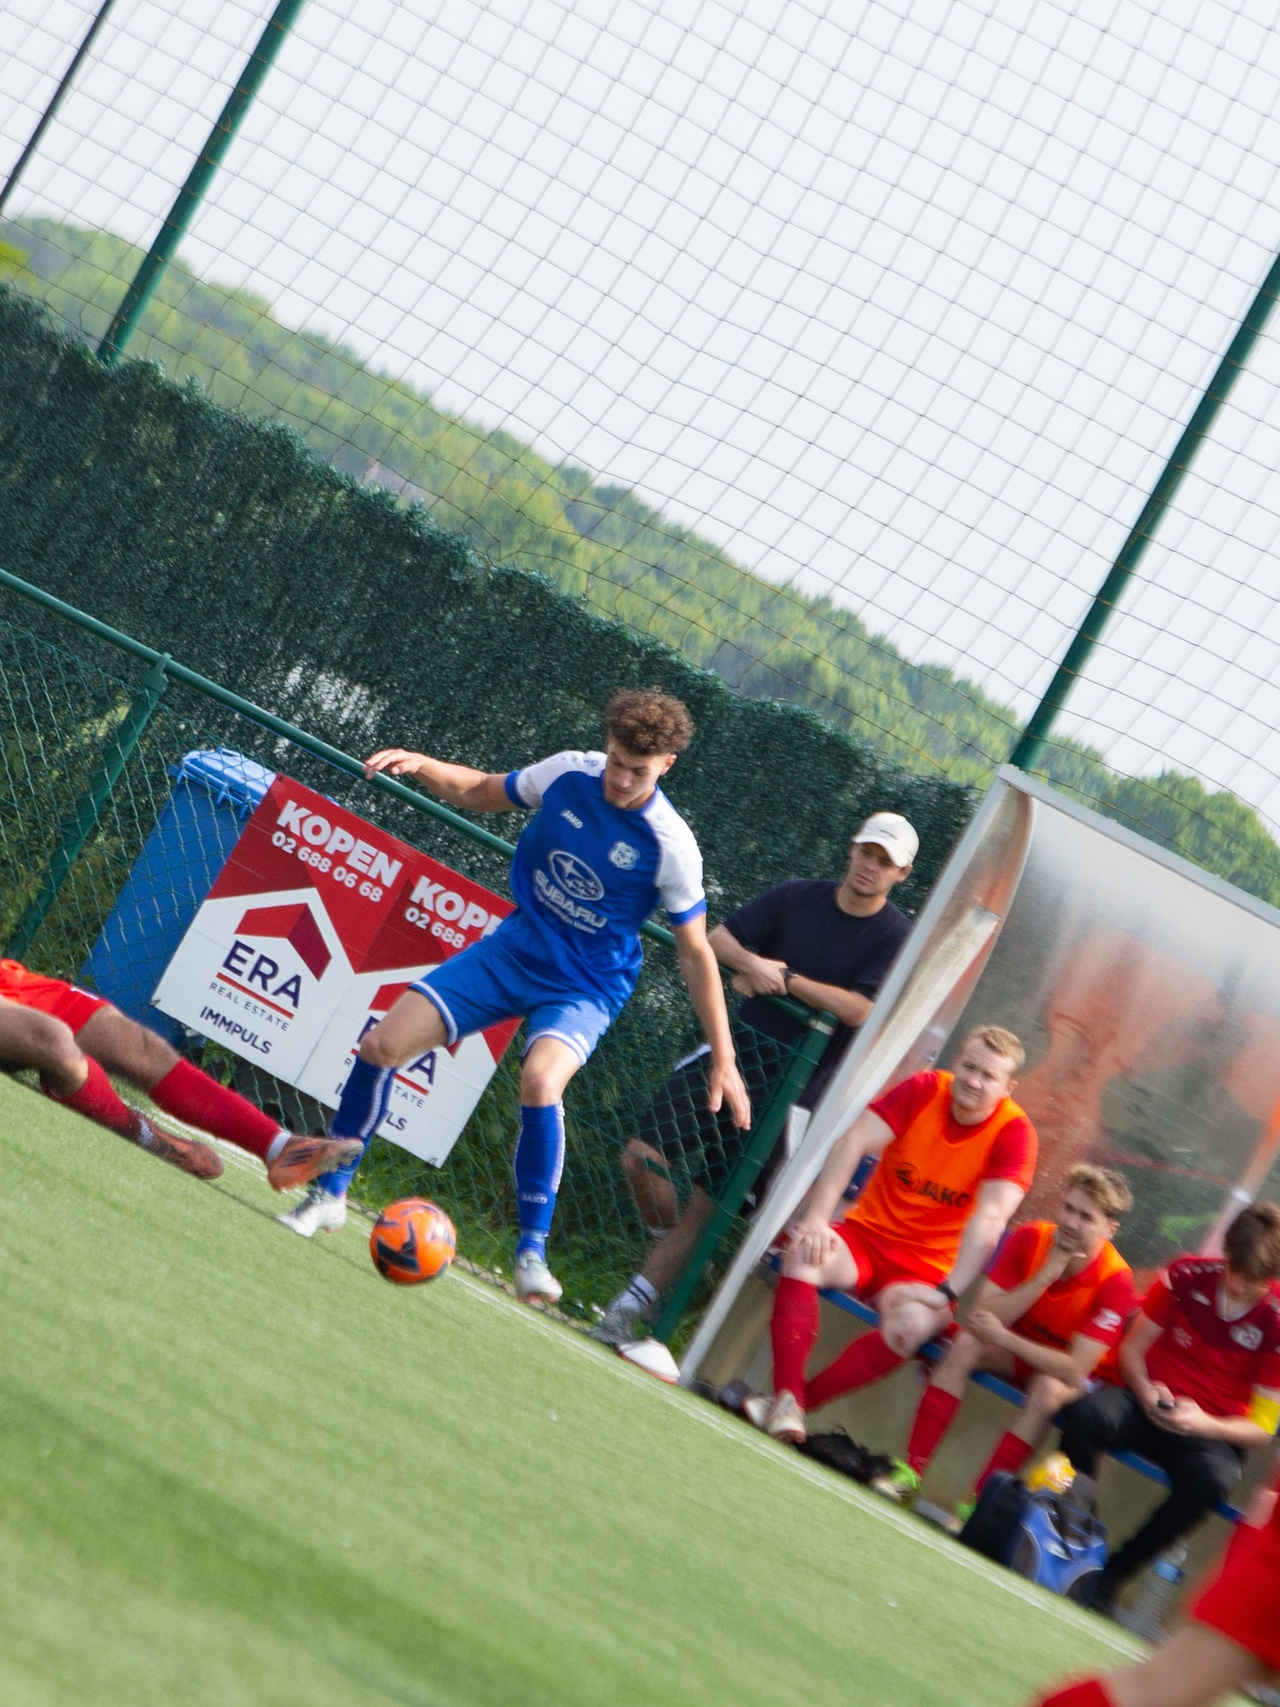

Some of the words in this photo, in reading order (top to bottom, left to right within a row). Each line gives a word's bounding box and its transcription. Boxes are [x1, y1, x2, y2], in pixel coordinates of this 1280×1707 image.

[271, 831, 298, 855] 02
[297, 846, 333, 874] 688
[332, 866, 359, 889] 06
[358, 881, 384, 903] 68
[276, 799, 403, 888] KOPEN
[532, 868, 608, 928] SUBARU
[404, 907, 431, 930] 02
[430, 921, 466, 949] 688
[222, 940, 302, 1009] ERA
[200, 1006, 272, 1055] IMMPULS
[209, 982, 239, 1005] REAL
[243, 1001, 290, 1032] ESTATE
[394, 1085, 426, 1109] TATE
[917, 1180, 972, 1208] JAKO
